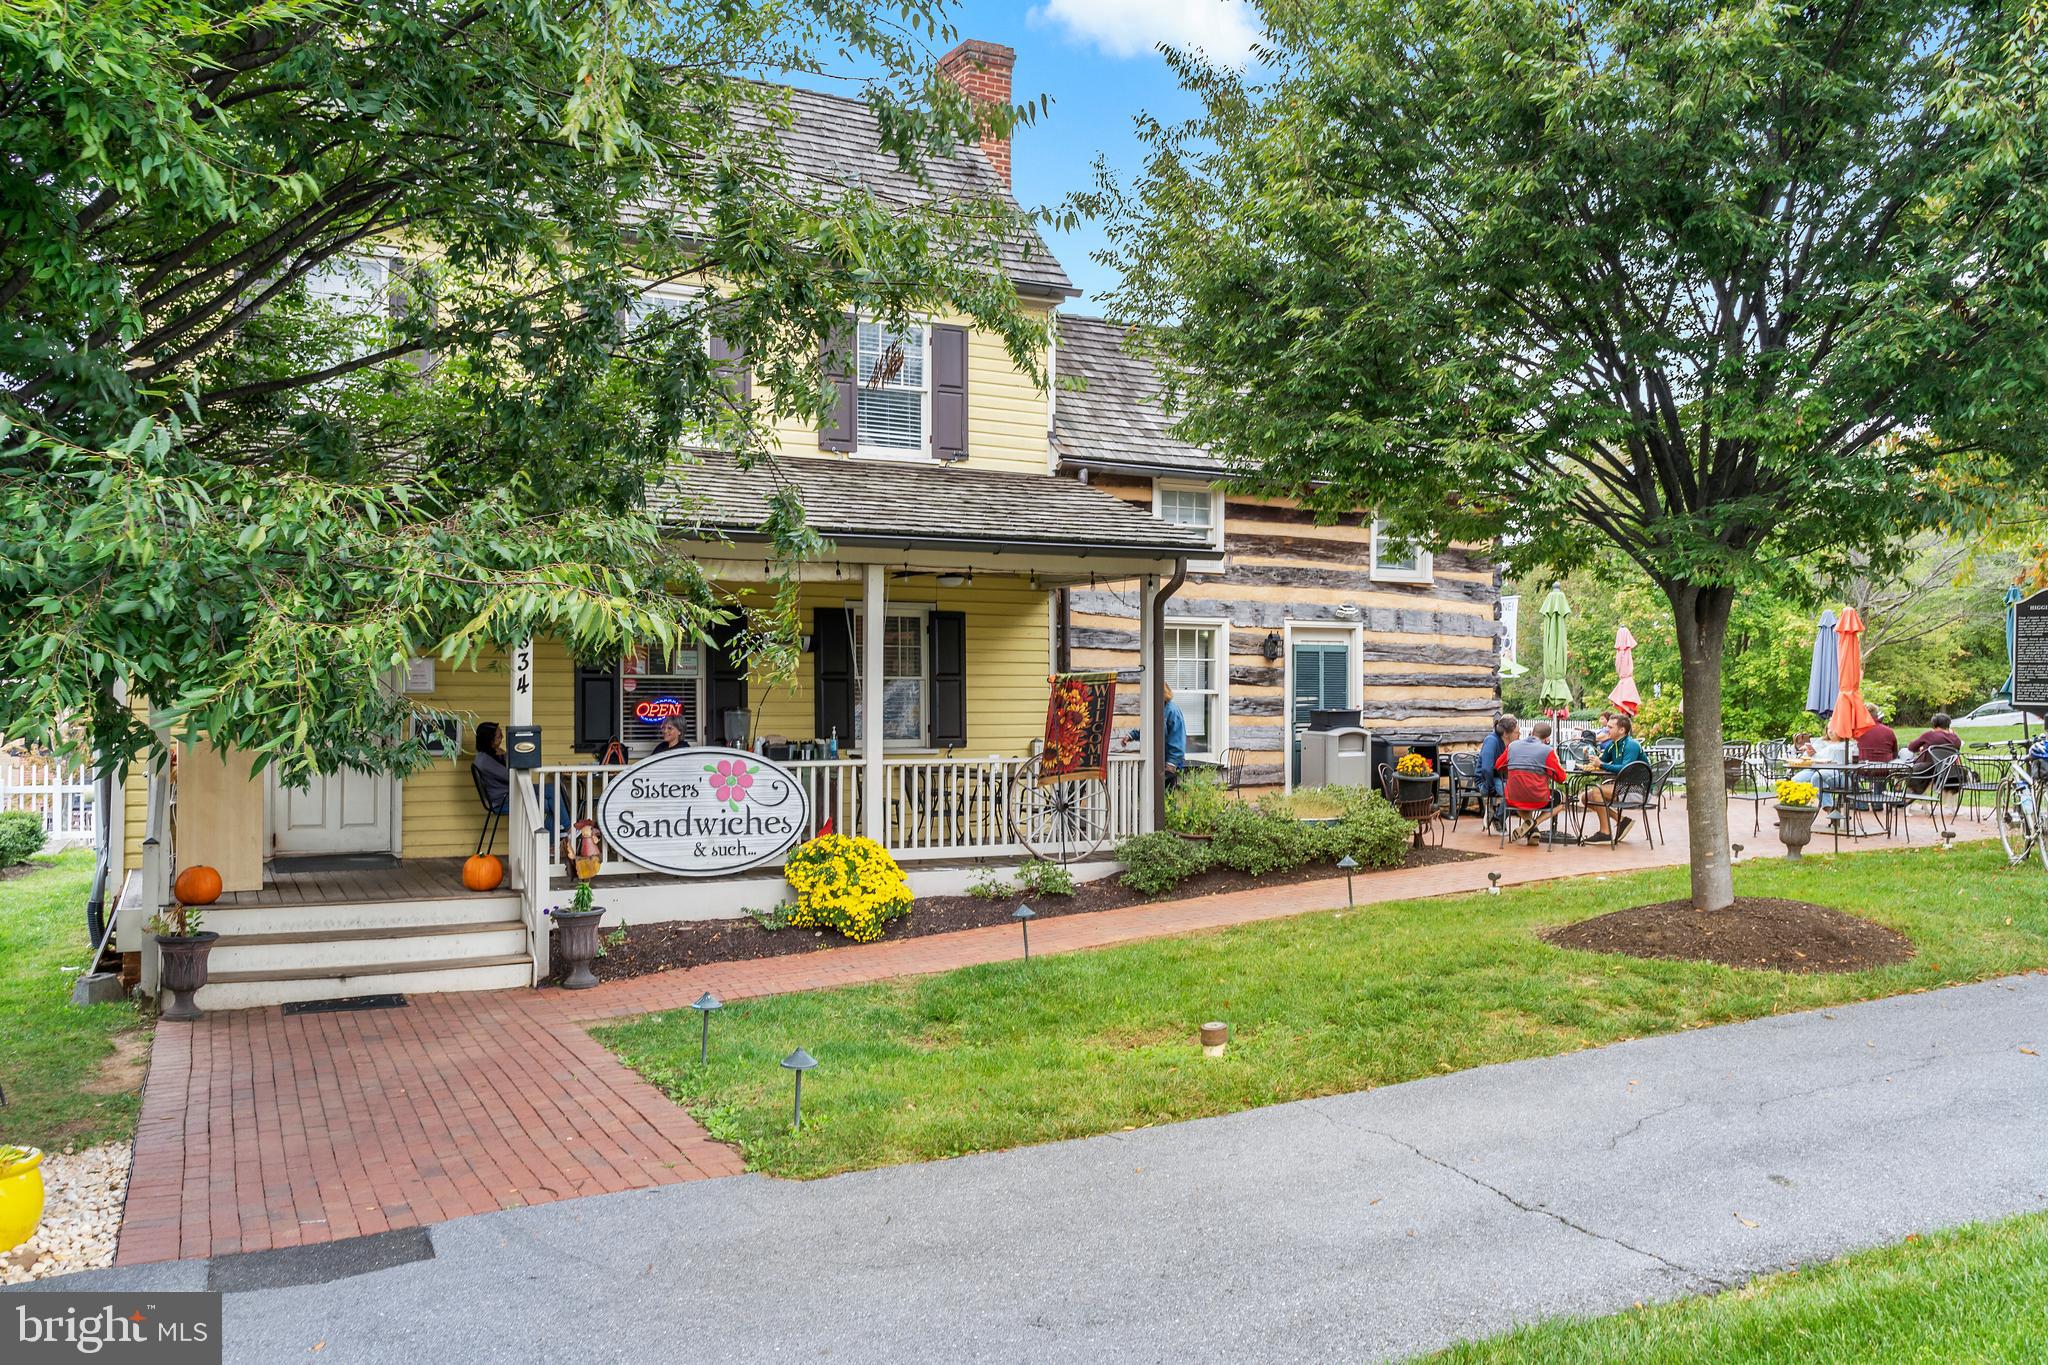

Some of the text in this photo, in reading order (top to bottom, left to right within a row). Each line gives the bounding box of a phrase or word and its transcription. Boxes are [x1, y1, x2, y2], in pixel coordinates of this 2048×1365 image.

[636, 702, 682, 717] OPEN
[1088, 684, 1109, 766] WELCOME
[630, 777, 702, 799] Sisters'
[617, 804, 793, 839] Sandwiches
[693, 839, 757, 857] & such...
